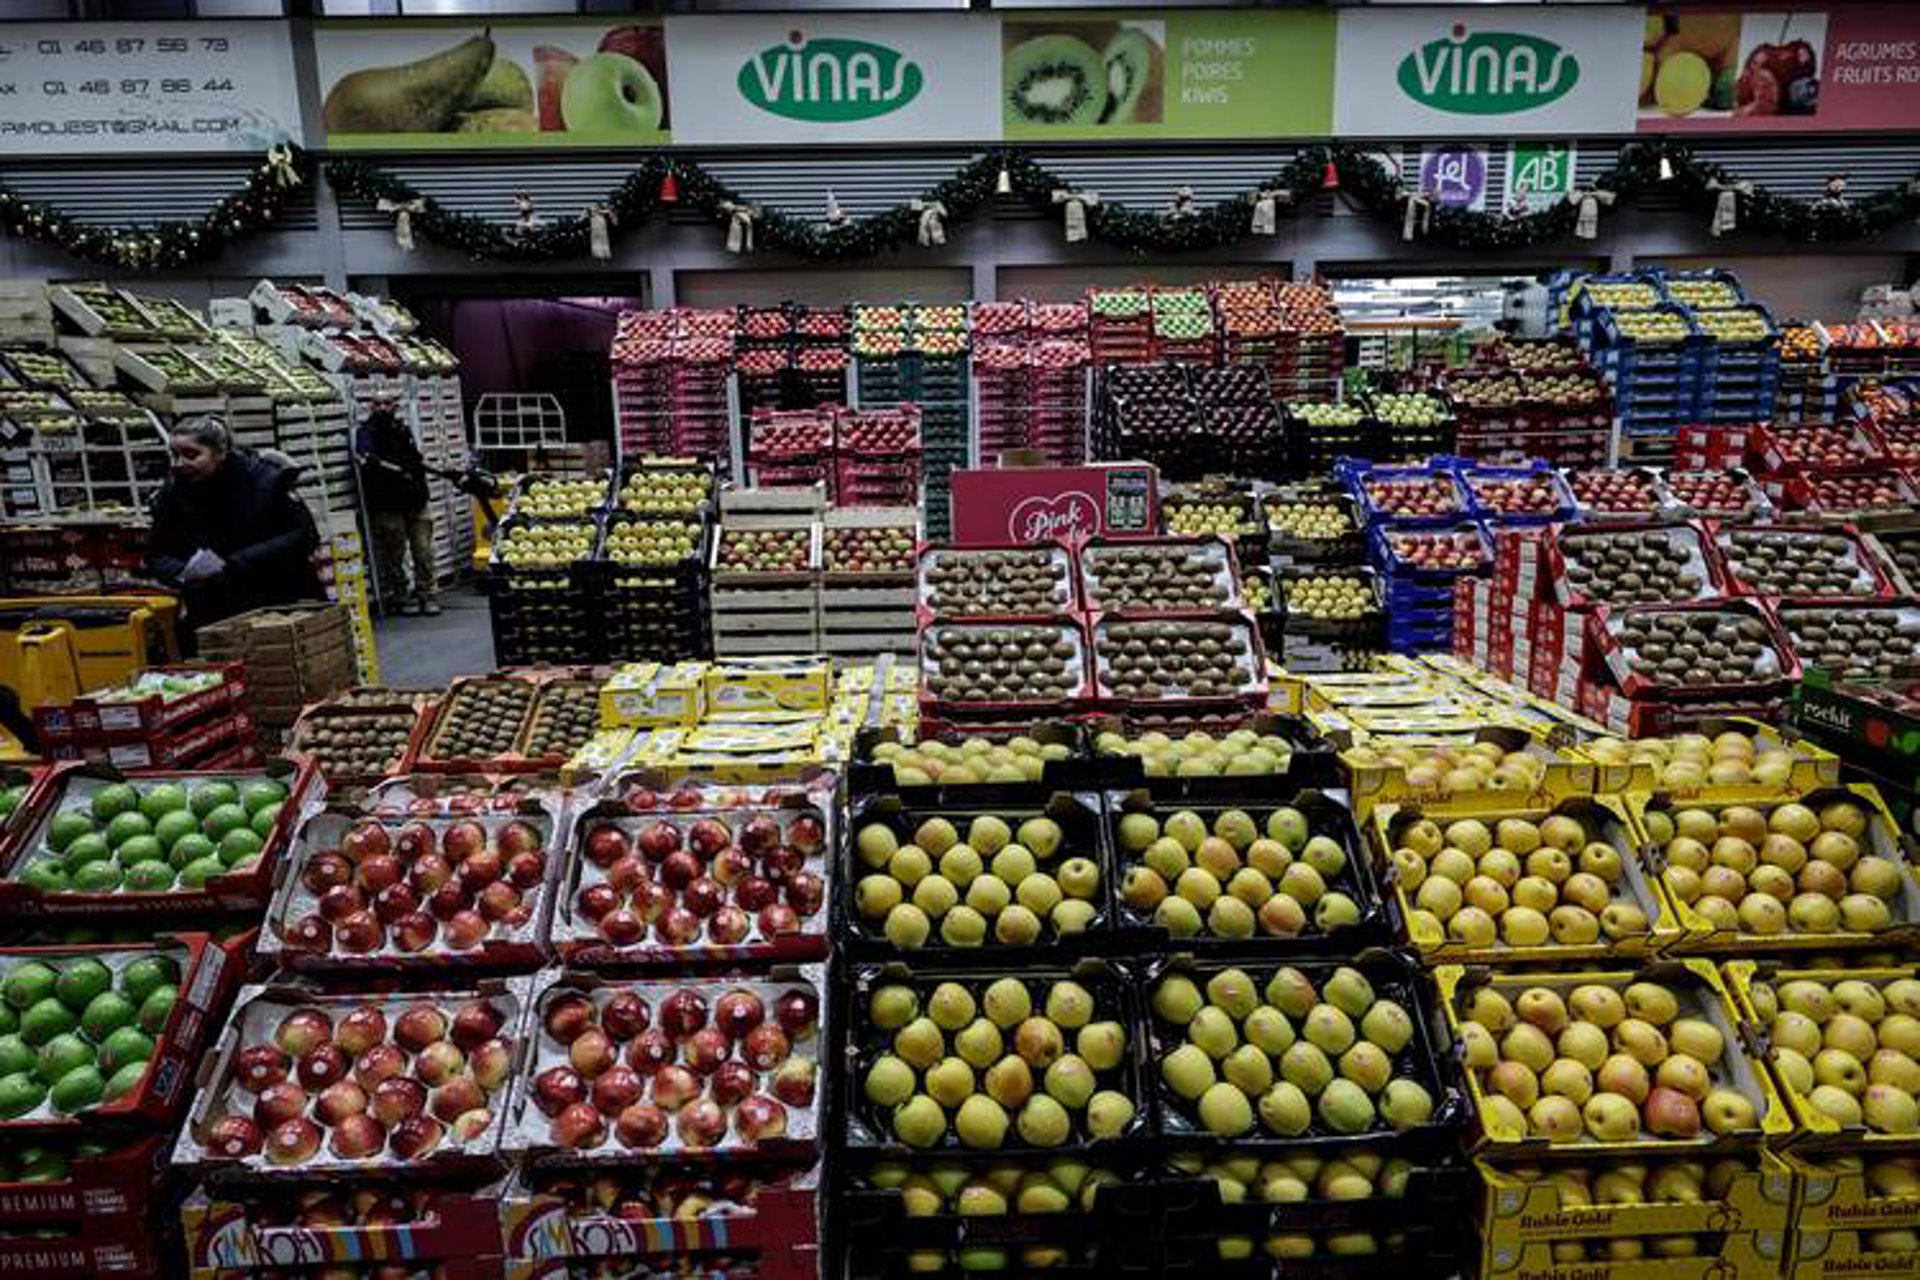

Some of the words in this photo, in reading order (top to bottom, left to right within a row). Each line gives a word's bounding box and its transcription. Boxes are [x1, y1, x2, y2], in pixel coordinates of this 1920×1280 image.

[37, 39, 62, 54] 01
[1182, 38, 1254, 57] POMMES
[1836, 42, 1917, 60] AGRUMES
[1182, 61, 1243, 80] POIRES
[1832, 66, 1893, 83] FRUITS
[202, 76, 235, 91] 44
[1182, 86, 1228, 103] KIWIS
[1515, 156, 1558, 191] AB
[1023, 501, 1082, 540] Pink
[1803, 701, 1851, 729] rockit
[1571, 1211, 1613, 1227] Gold
[0, 1250, 85, 1271] PREMIUM
